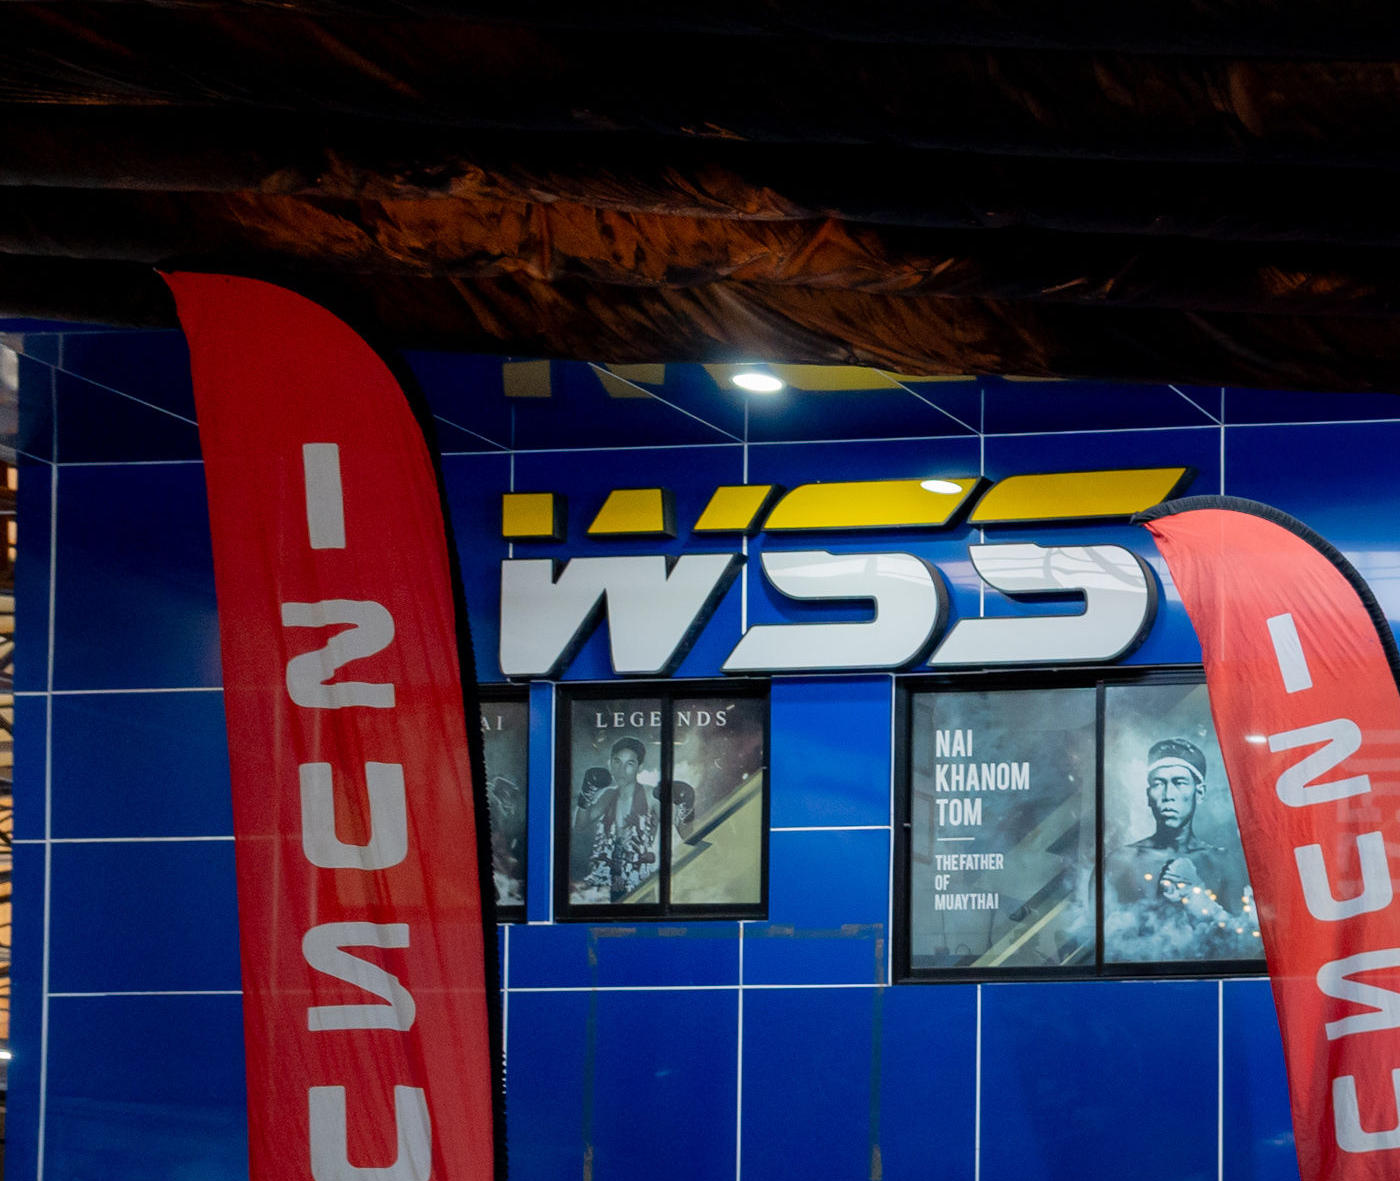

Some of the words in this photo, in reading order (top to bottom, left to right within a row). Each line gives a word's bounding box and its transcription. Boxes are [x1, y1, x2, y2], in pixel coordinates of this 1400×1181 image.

[500, 467, 1188, 676] WSS
[595, 711, 728, 728] LEGENDS
[936, 729, 973, 757] NAI
[935, 762, 1030, 792] KHANOM
[936, 798, 982, 826] TOM
[935, 875, 950, 890] OF
